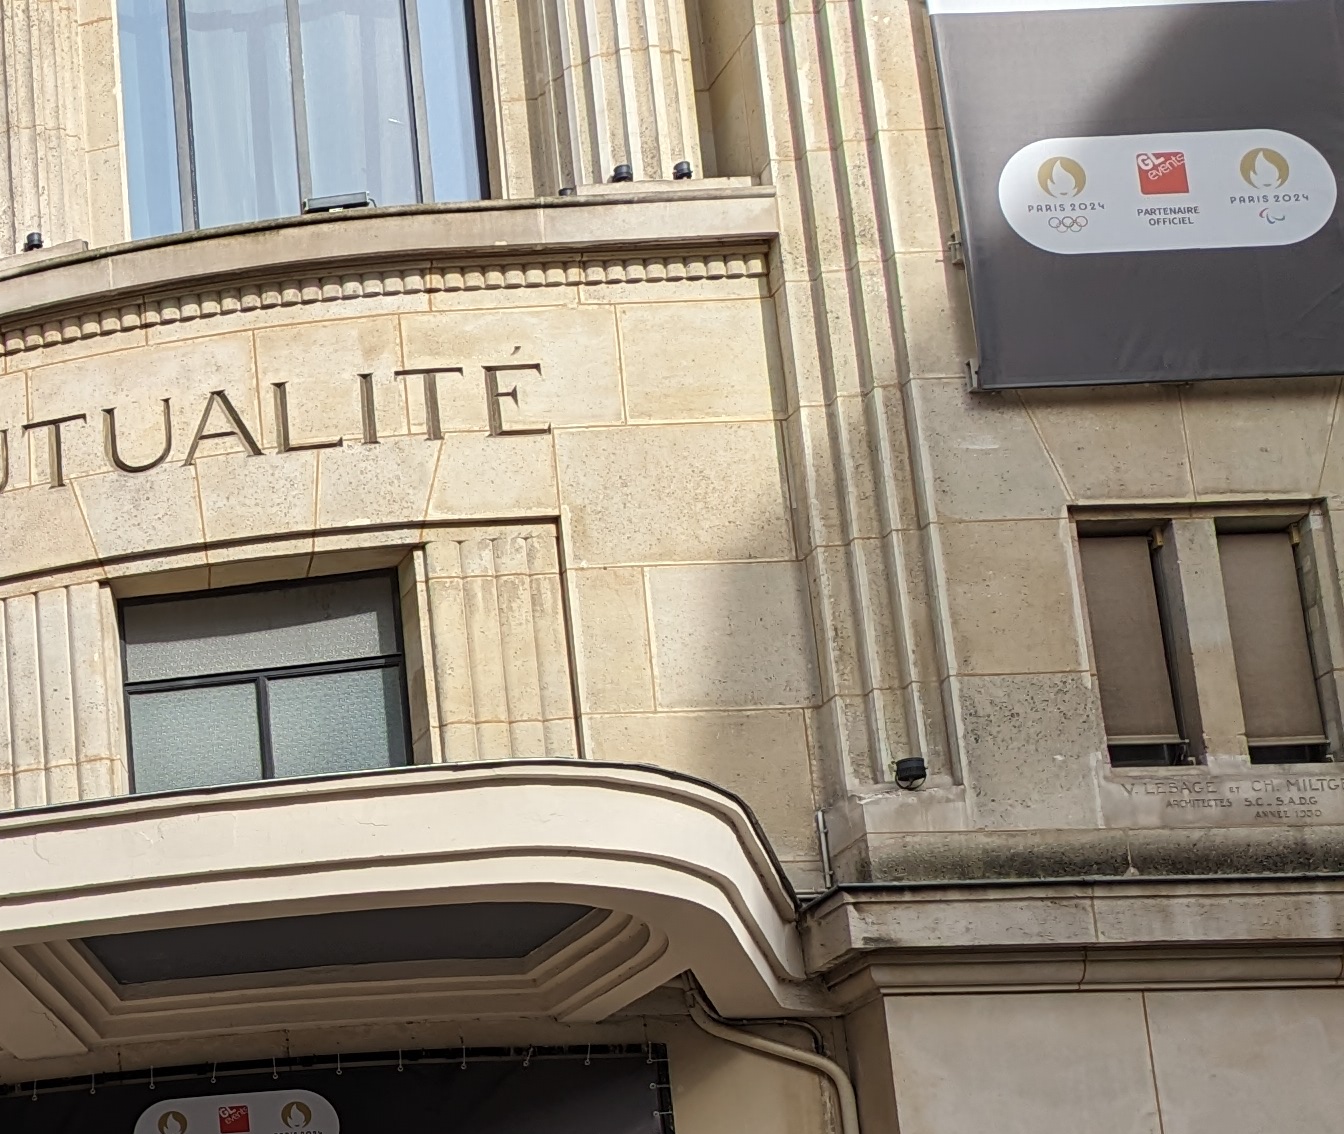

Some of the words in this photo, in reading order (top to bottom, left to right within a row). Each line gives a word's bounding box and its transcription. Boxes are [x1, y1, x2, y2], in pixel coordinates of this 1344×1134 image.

[1137, 153, 1165, 171] GL
[1147, 154, 1185, 180] events
[1230, 194, 1269, 204] PARIS
[1273, 192, 1309, 203] 2024
[1027, 203, 1066, 213] PARIS
[1069, 201, 1105, 212] 2024
[1137, 206, 1200, 216] PARTENAIRE
[1148, 217, 1194, 226] OFFICIEL
[1144, 781, 1217, 795] LESAGE
[1252, 779, 1279, 793] CH.
[219, 1106, 237, 1118] GL
[224, 1106, 249, 1125] events
